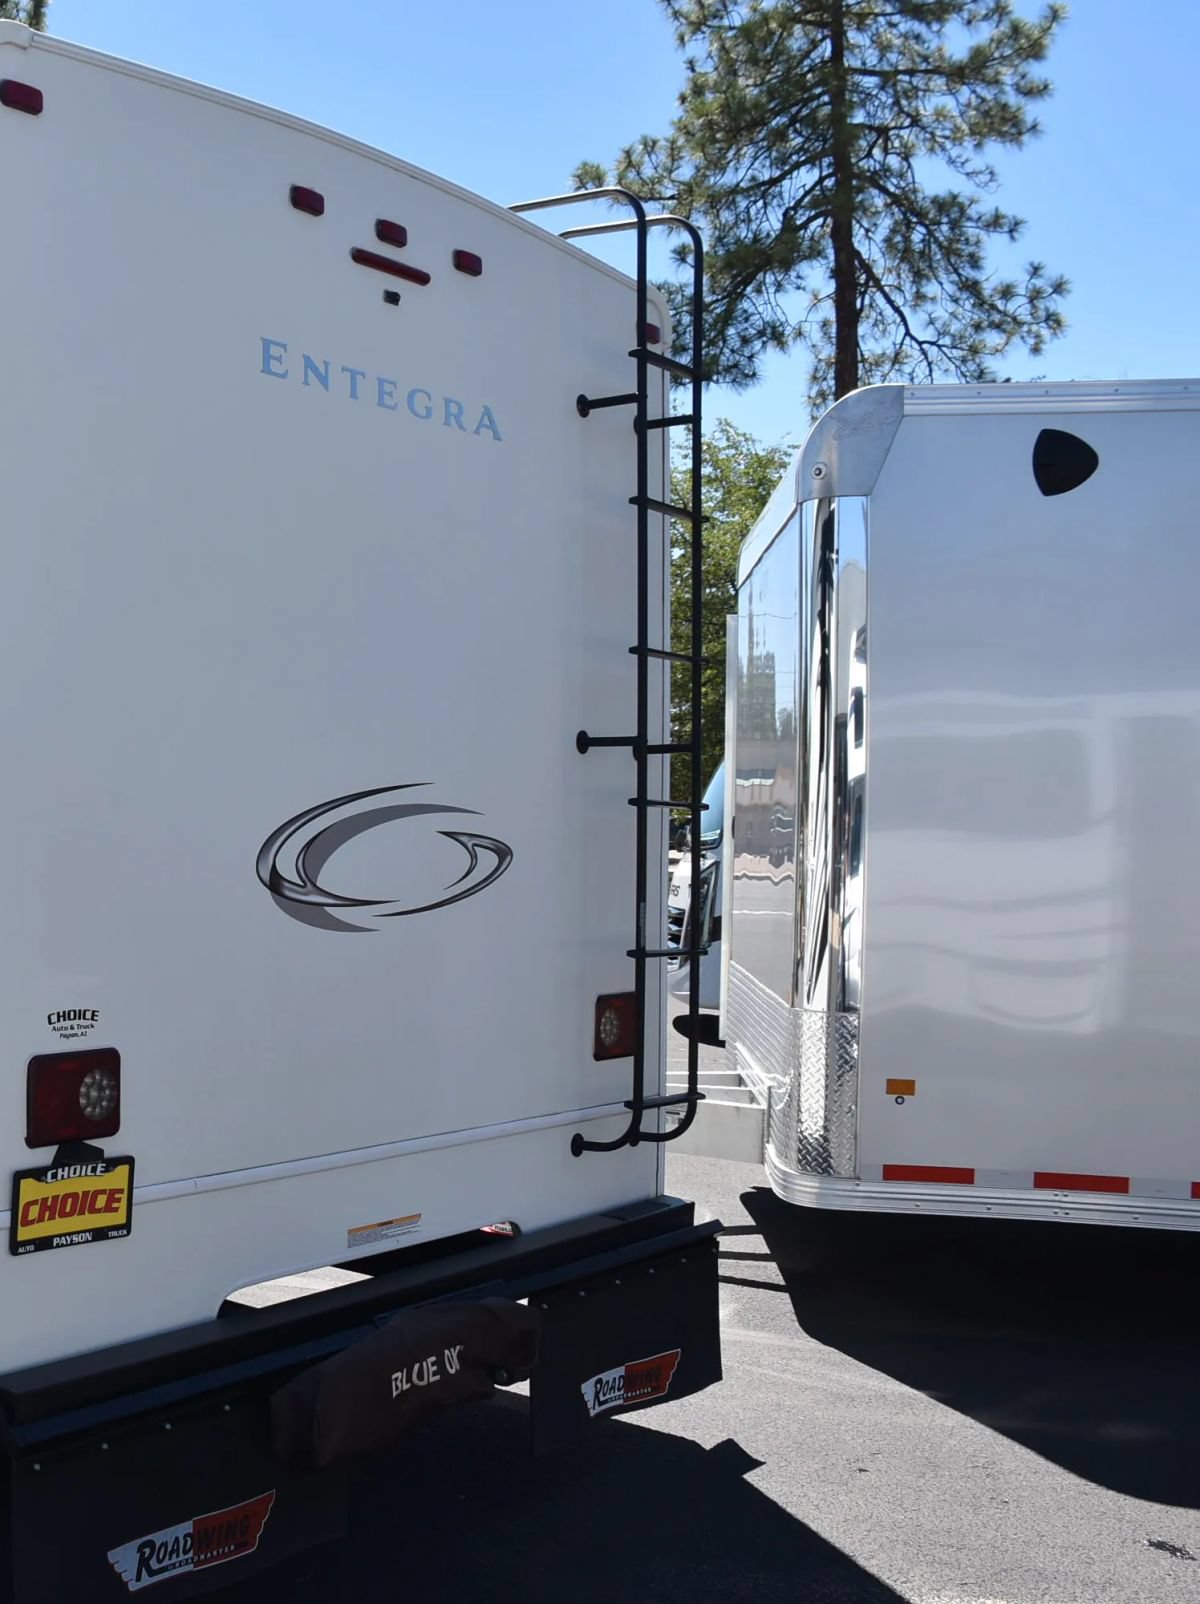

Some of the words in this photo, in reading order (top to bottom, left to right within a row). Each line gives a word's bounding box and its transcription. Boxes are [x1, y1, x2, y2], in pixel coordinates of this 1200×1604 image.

[259, 336, 503, 442] ENTEGRA
[47, 1008, 100, 1026] CHOICE
[46, 1163, 106, 1183] CHOICE
[19, 1188, 125, 1228] CHOICE
[53, 1232, 93, 1247] PAYSON
[108, 1229, 128, 1238] TRUCK
[391, 1355, 441, 1398] BLUE
